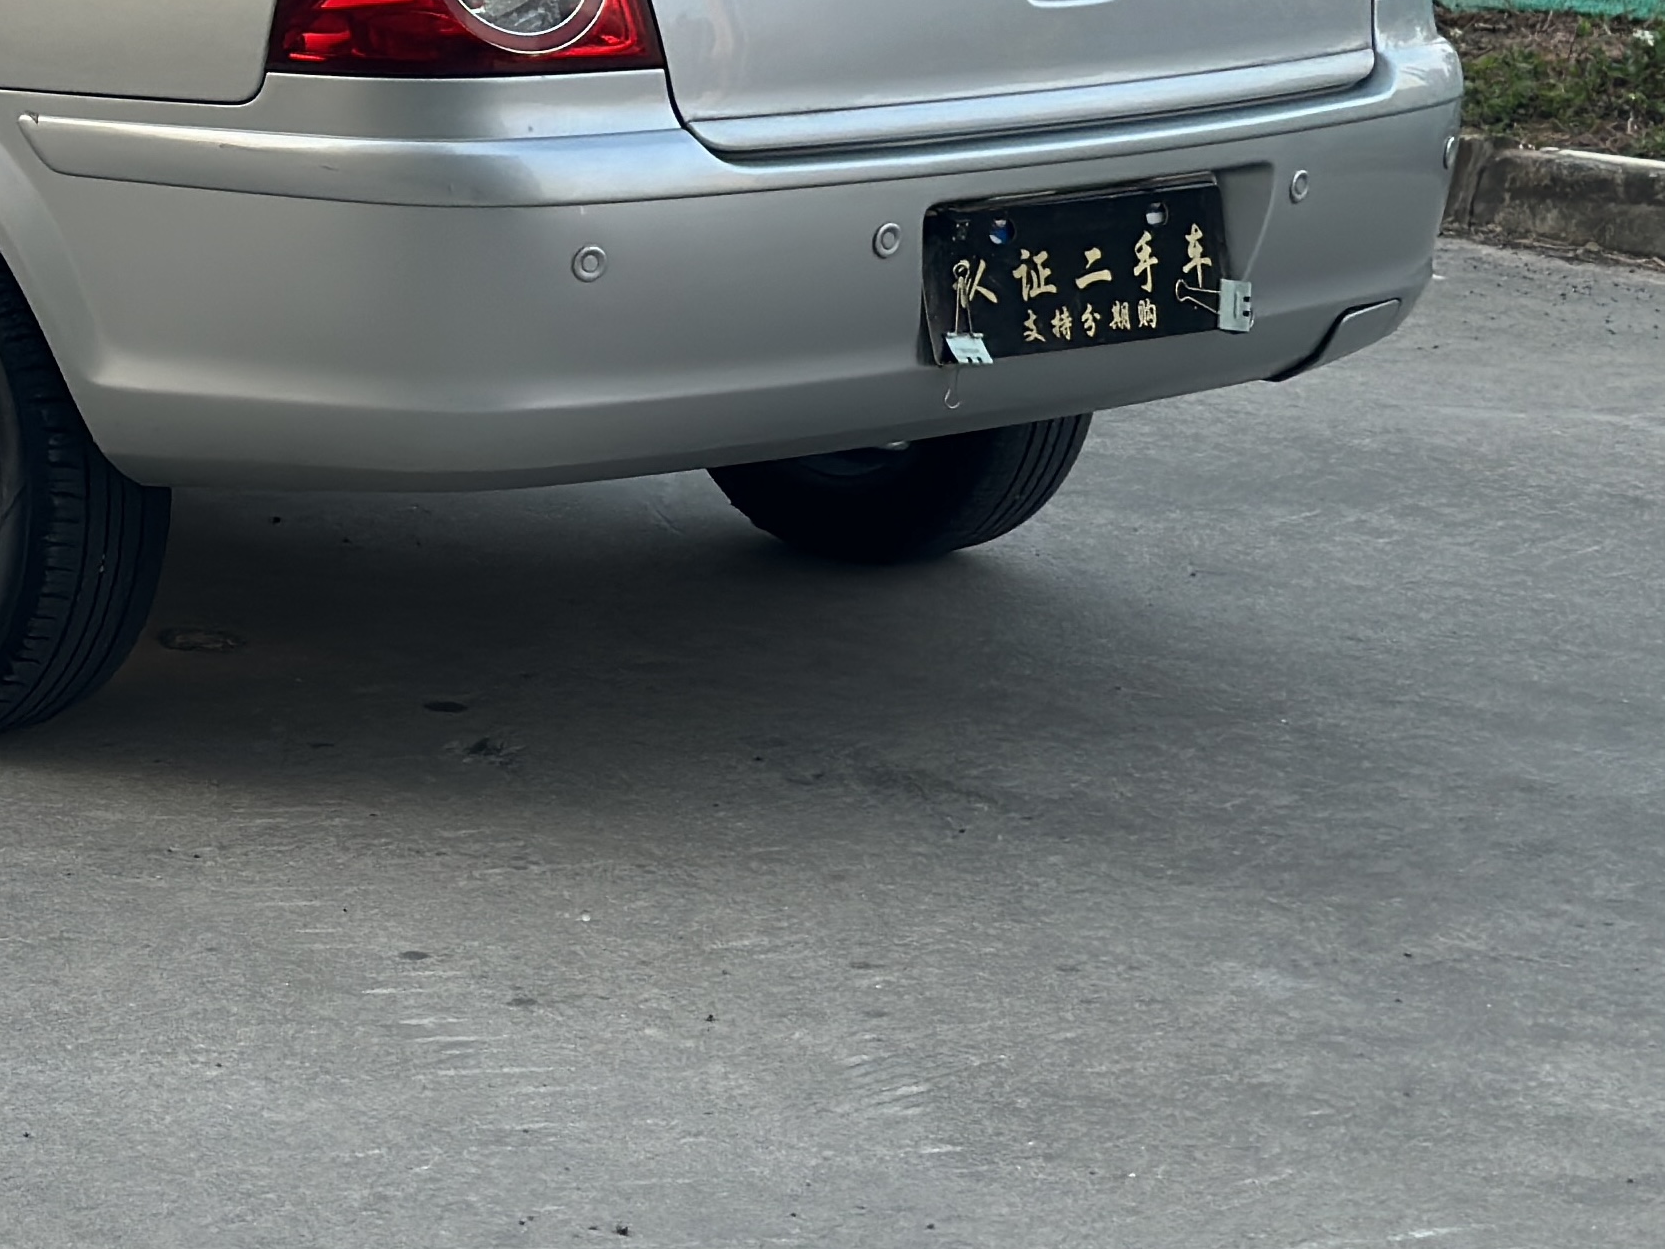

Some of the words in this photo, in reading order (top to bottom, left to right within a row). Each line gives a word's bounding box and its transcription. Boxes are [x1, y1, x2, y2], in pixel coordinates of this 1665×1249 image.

[1023, 298, 1158, 342] 支持分期购
